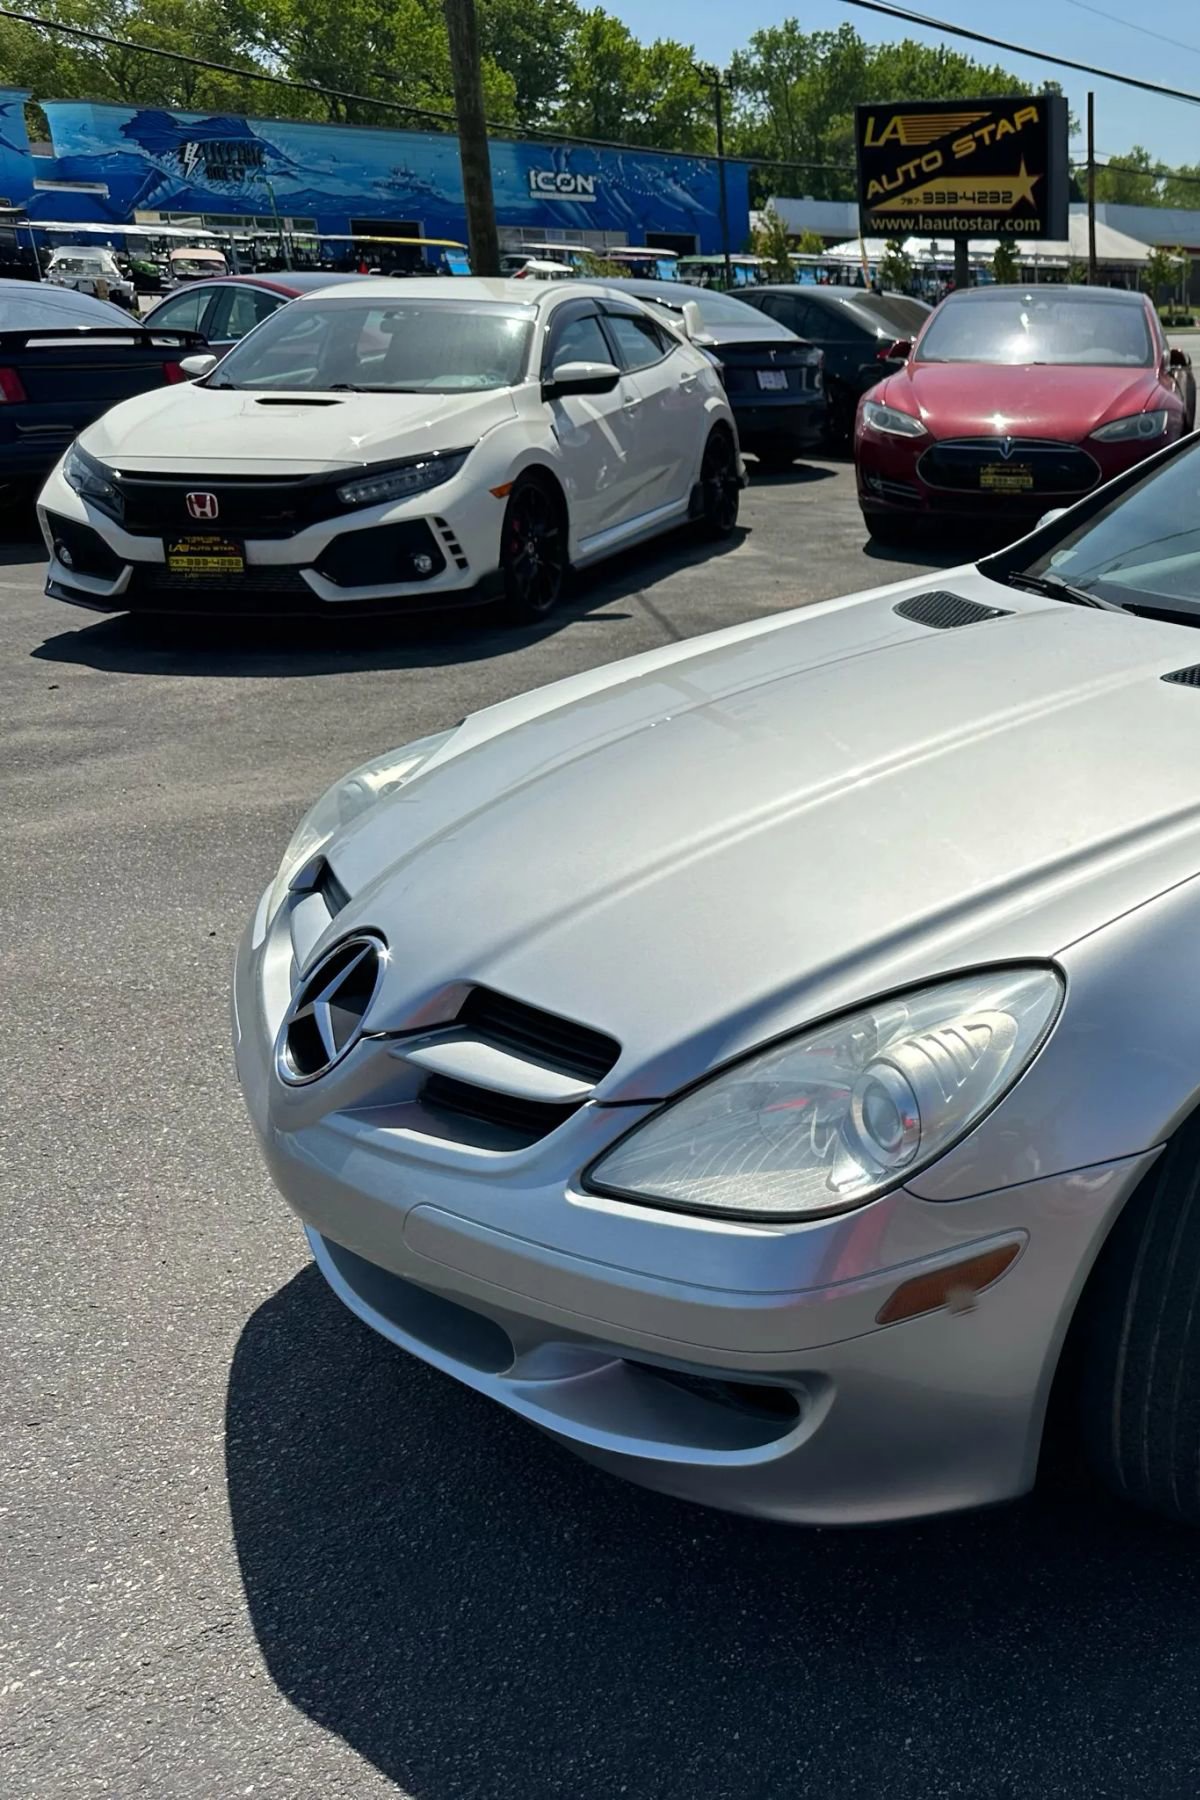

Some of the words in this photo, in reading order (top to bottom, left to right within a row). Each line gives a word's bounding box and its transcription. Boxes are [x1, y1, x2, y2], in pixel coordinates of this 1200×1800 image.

[864, 116, 906, 147] LA
[866, 150, 943, 200] AUTO
[952, 105, 1040, 159] STAR
[529, 170, 594, 194] ICON
[871, 214, 1041, 232] www.laautostar.com
